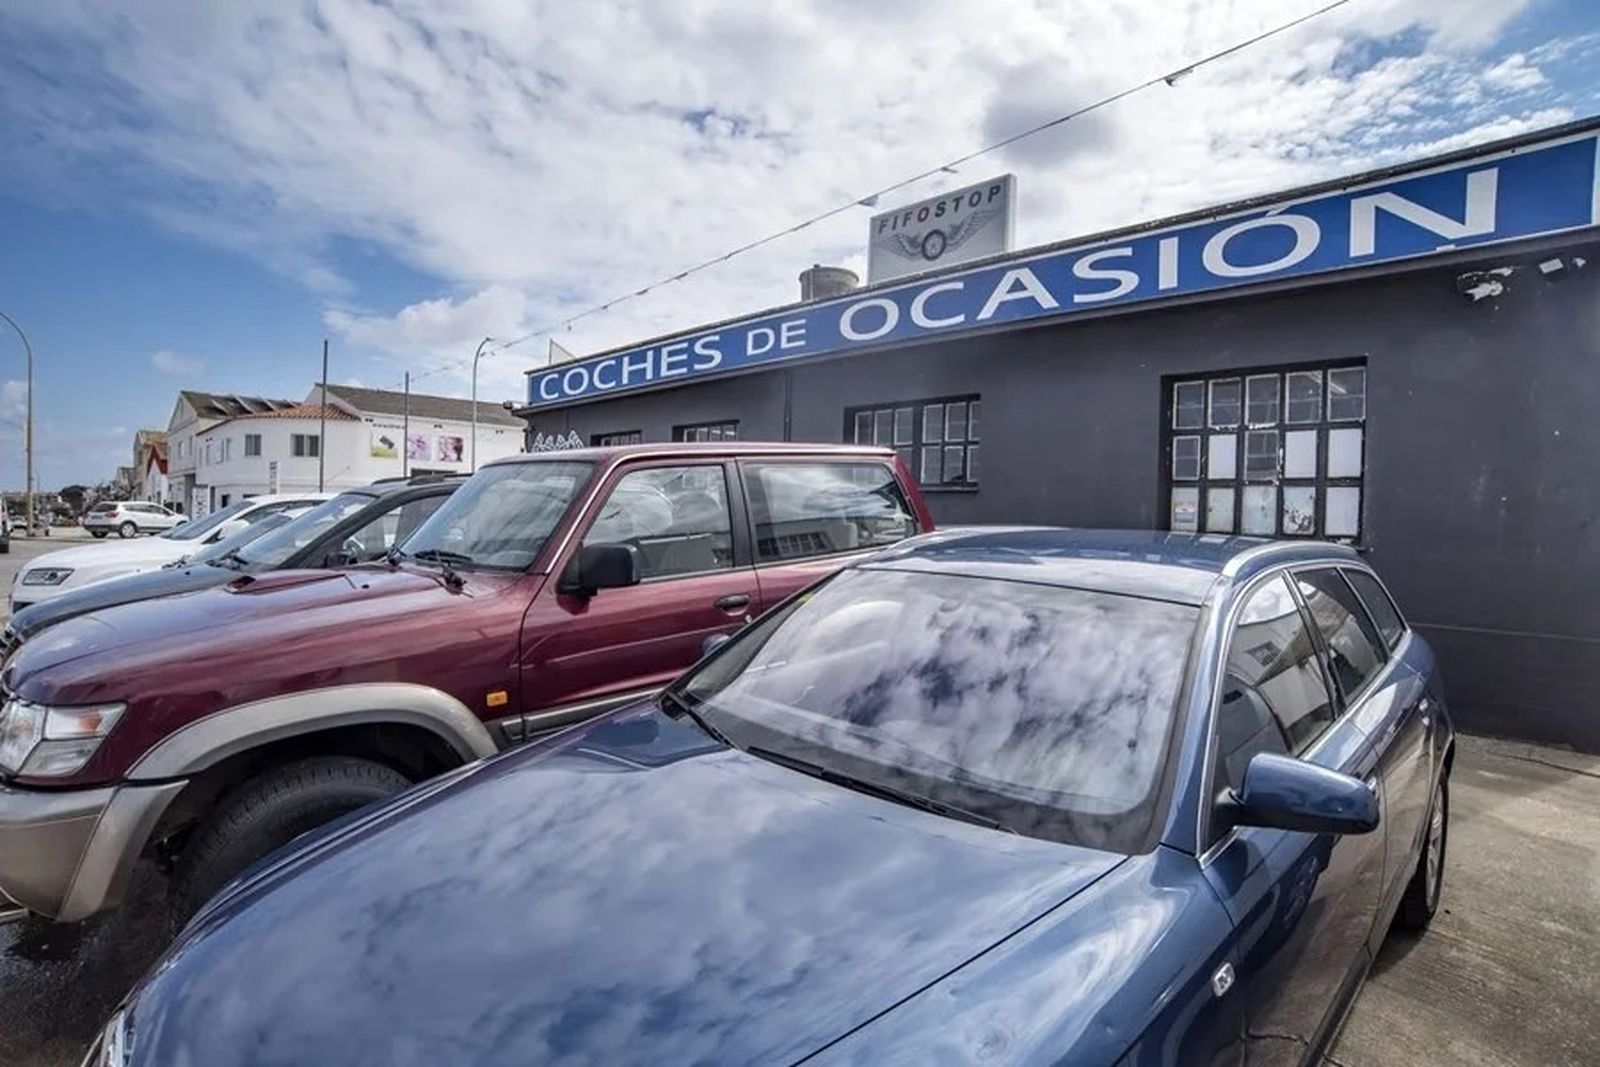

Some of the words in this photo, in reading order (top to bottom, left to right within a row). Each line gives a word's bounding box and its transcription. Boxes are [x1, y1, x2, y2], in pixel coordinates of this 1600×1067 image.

[878, 184, 1002, 234] FIFOSTOP
[539, 334, 723, 400] COCHES
[746, 318, 807, 356] DE
[839, 167, 1499, 341] OCASIÓN
